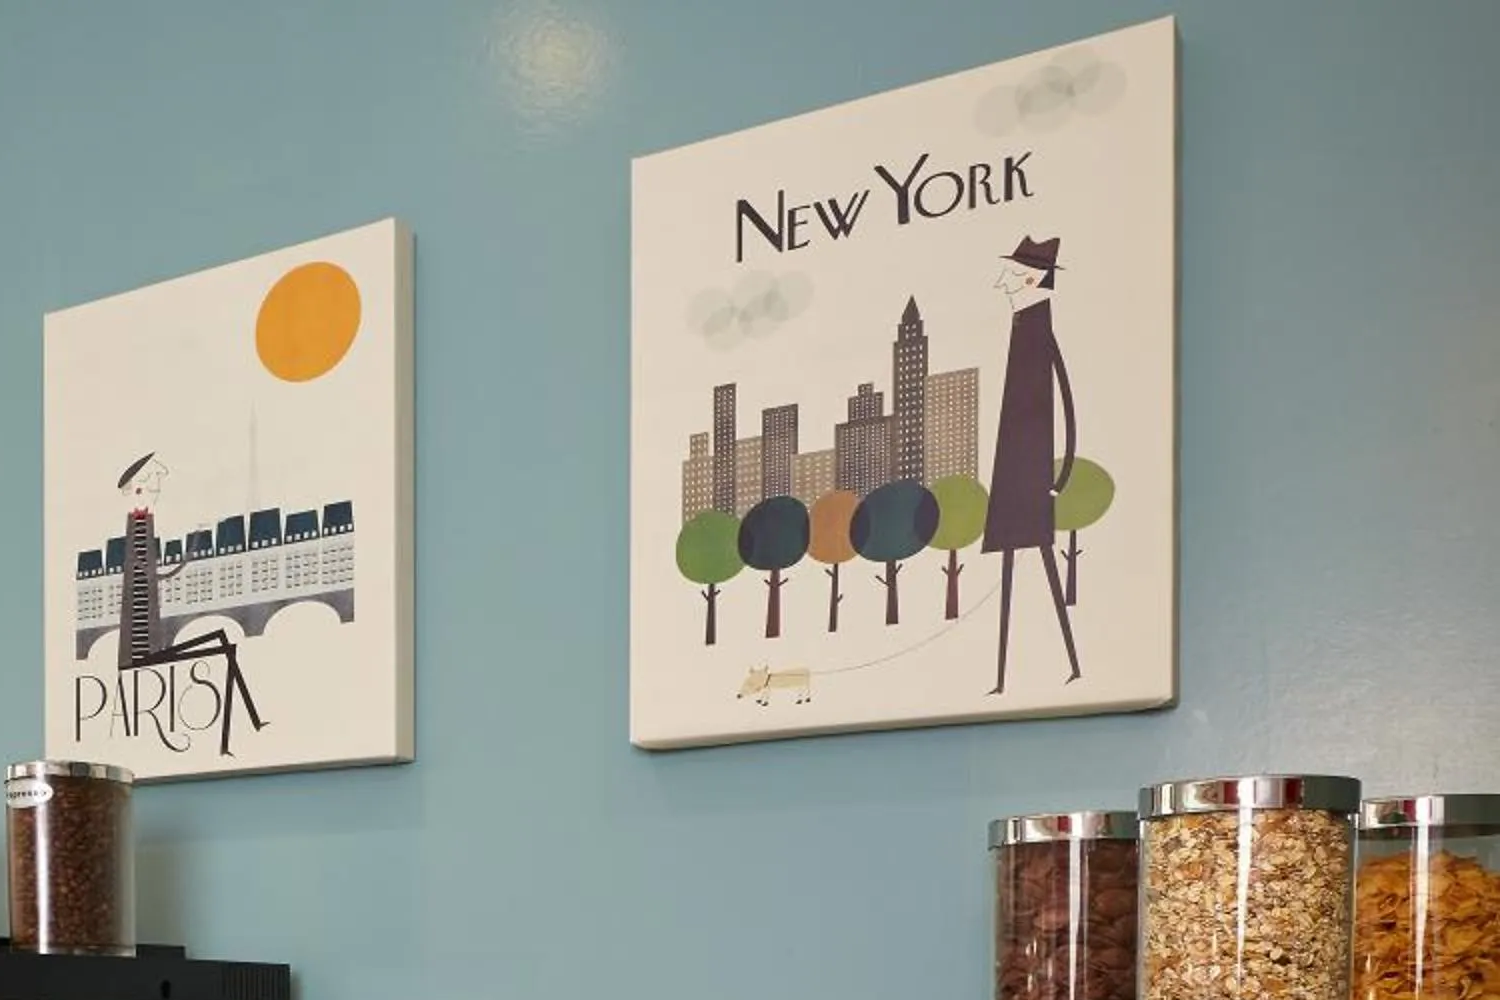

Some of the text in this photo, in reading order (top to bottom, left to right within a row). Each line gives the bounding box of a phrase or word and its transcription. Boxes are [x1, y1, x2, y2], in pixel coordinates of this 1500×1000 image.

[735, 151, 1034, 262] NEW YORK
[75, 660, 221, 753] PARIS
